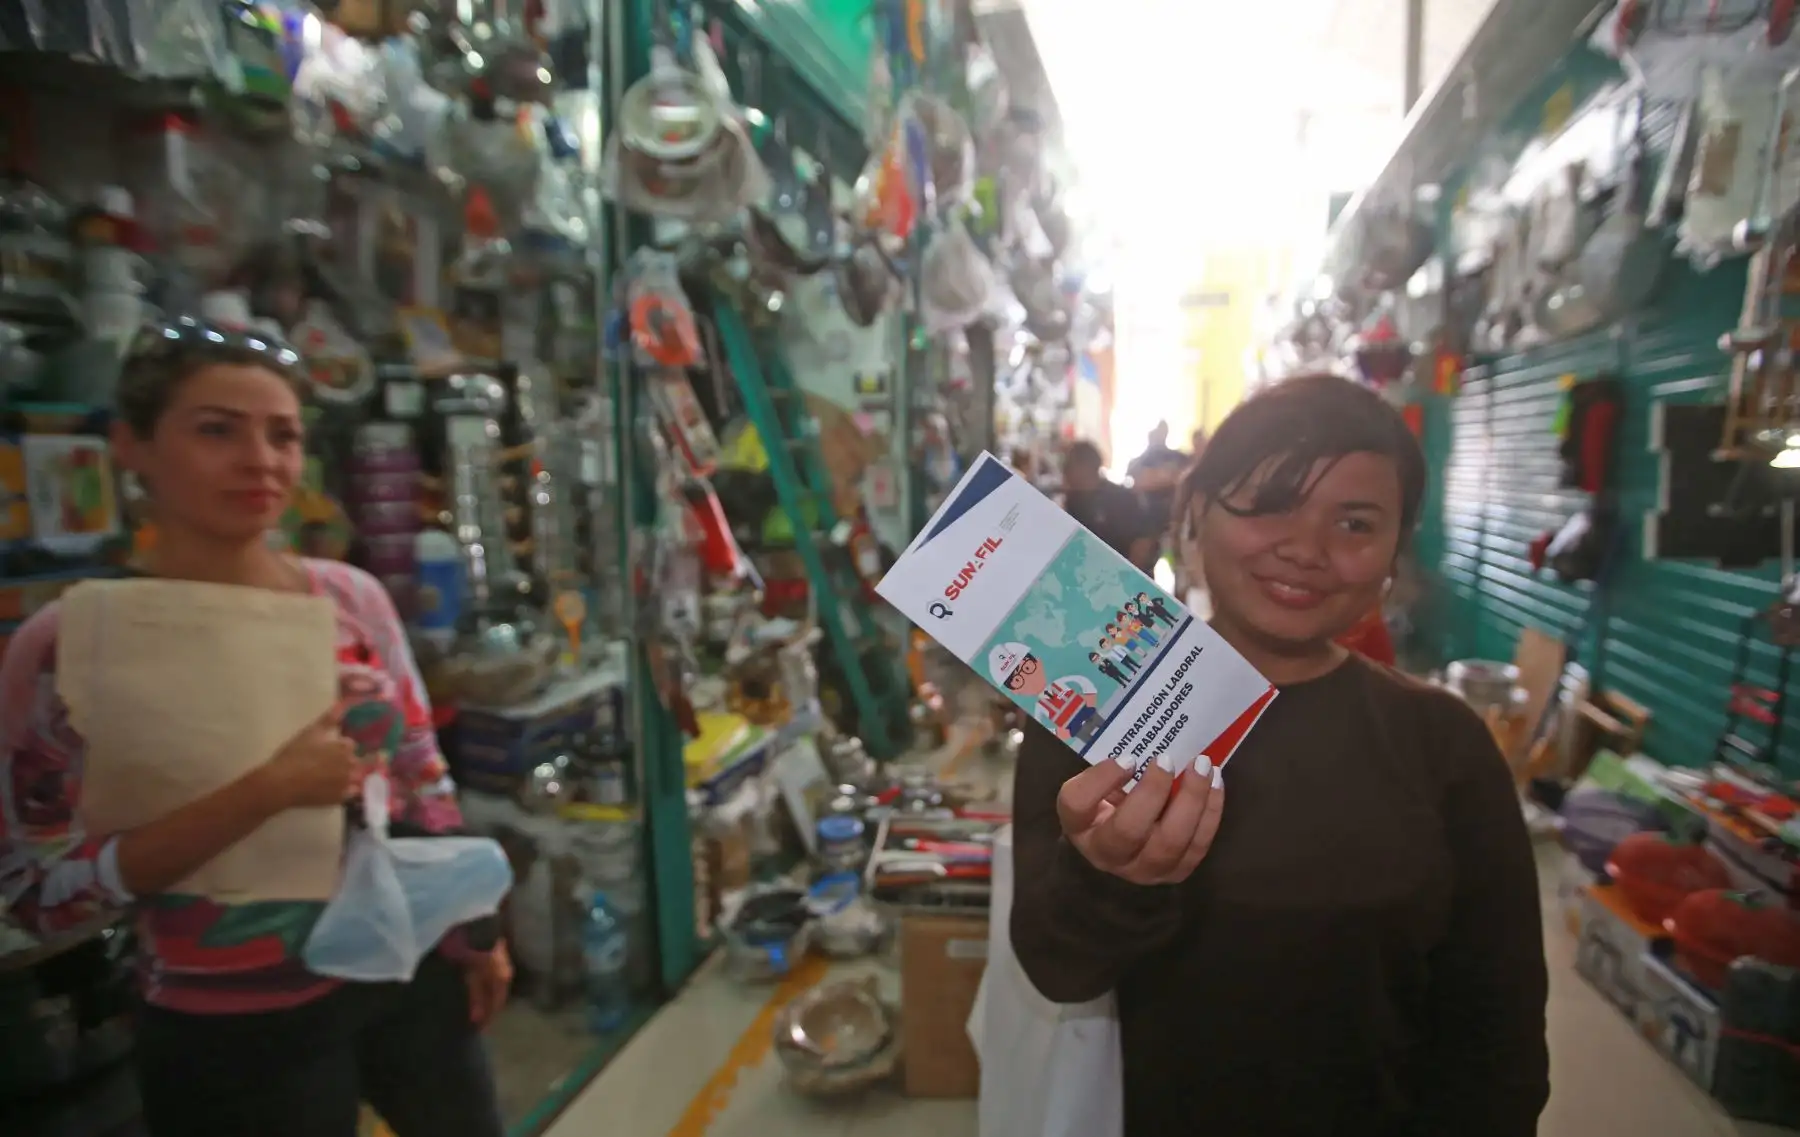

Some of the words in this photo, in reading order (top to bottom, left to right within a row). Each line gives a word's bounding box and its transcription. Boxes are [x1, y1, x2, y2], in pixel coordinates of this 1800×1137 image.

[1108, 689, 1169, 759] CONTRATACIÓN
[1165, 646, 1203, 692] LABORAL
[1131, 682, 1193, 758] TRABAJADORES
